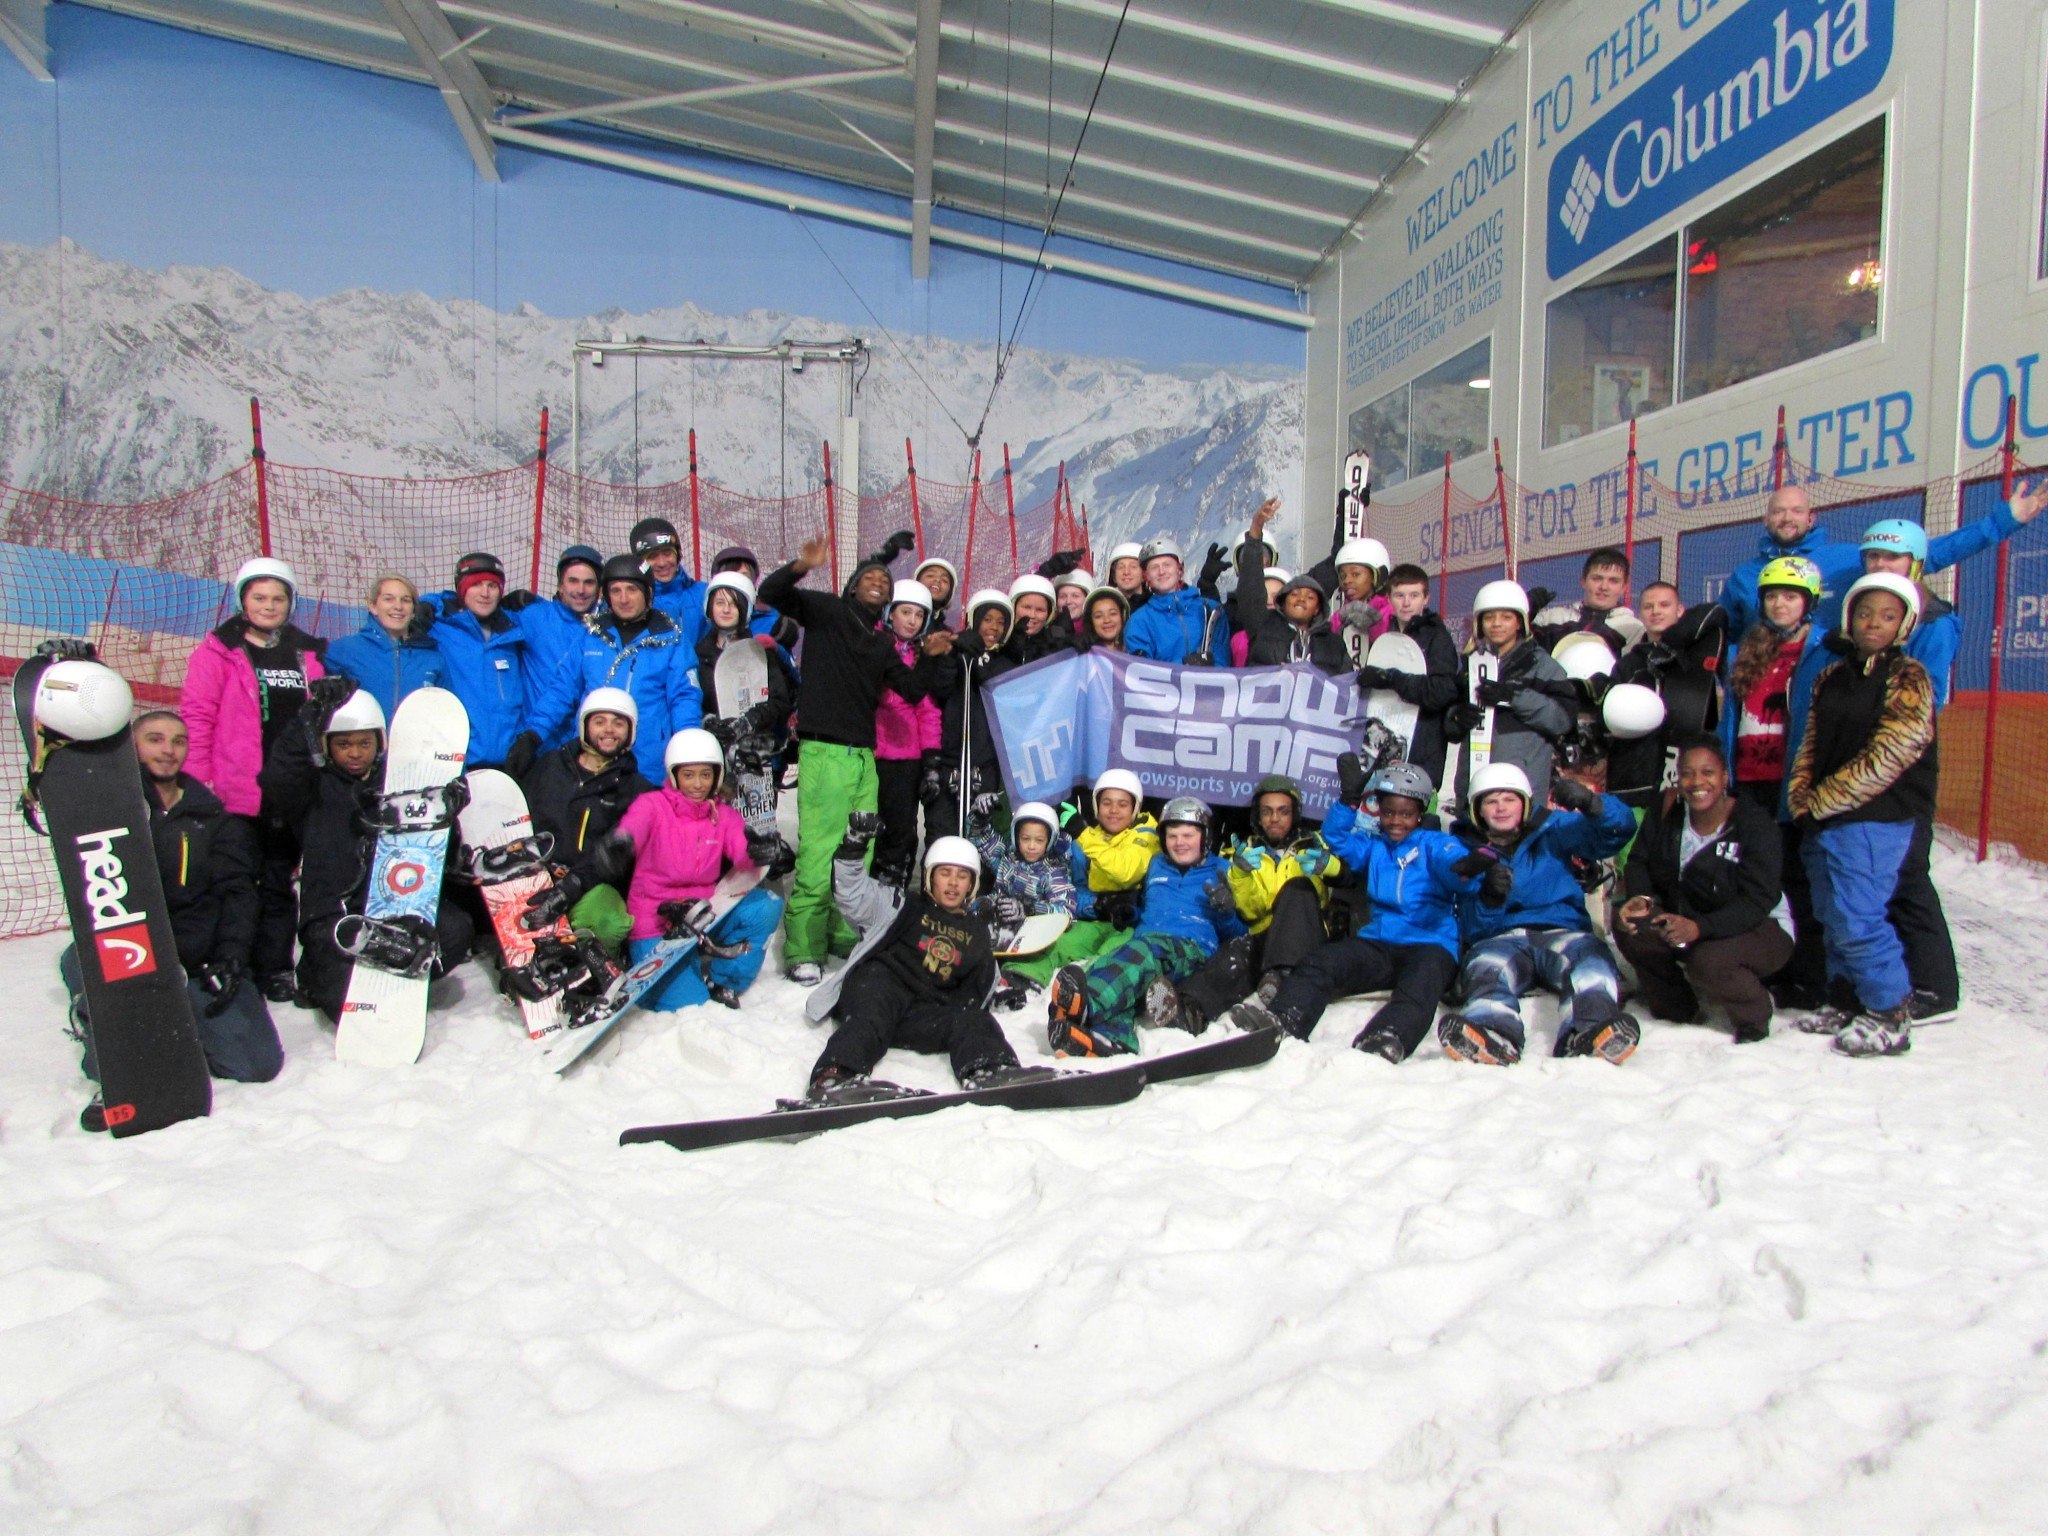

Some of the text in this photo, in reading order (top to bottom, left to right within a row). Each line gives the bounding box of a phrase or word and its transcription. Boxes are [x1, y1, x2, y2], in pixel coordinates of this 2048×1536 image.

[1405, 1, 1660, 255] WELCOME TO THE
[1604, 0, 1869, 208] Columbia
[1346, 208, 1503, 347] WE BELIEVE IN WALKING
[1359, 327, 1392, 365] SCHOOL
[1394, 304, 1430, 342] UPHILL
[1433, 276, 1463, 317] BOTH
[1468, 247, 1503, 294] WAYS
[1469, 280, 1502, 319] WATER
[1349, 464, 1362, 538] HEAD
[1420, 503, 1506, 564] SCENCE
[1523, 483, 1578, 544] FOR
[1589, 458, 1658, 529] THE
[1676, 390, 1915, 511] GREATER
[434, 753, 454, 762] head
[502, 817, 521, 828] head
[75, 826, 147, 931] head
[355, 1002, 377, 1014] head
[540, 1022, 563, 1039] head
